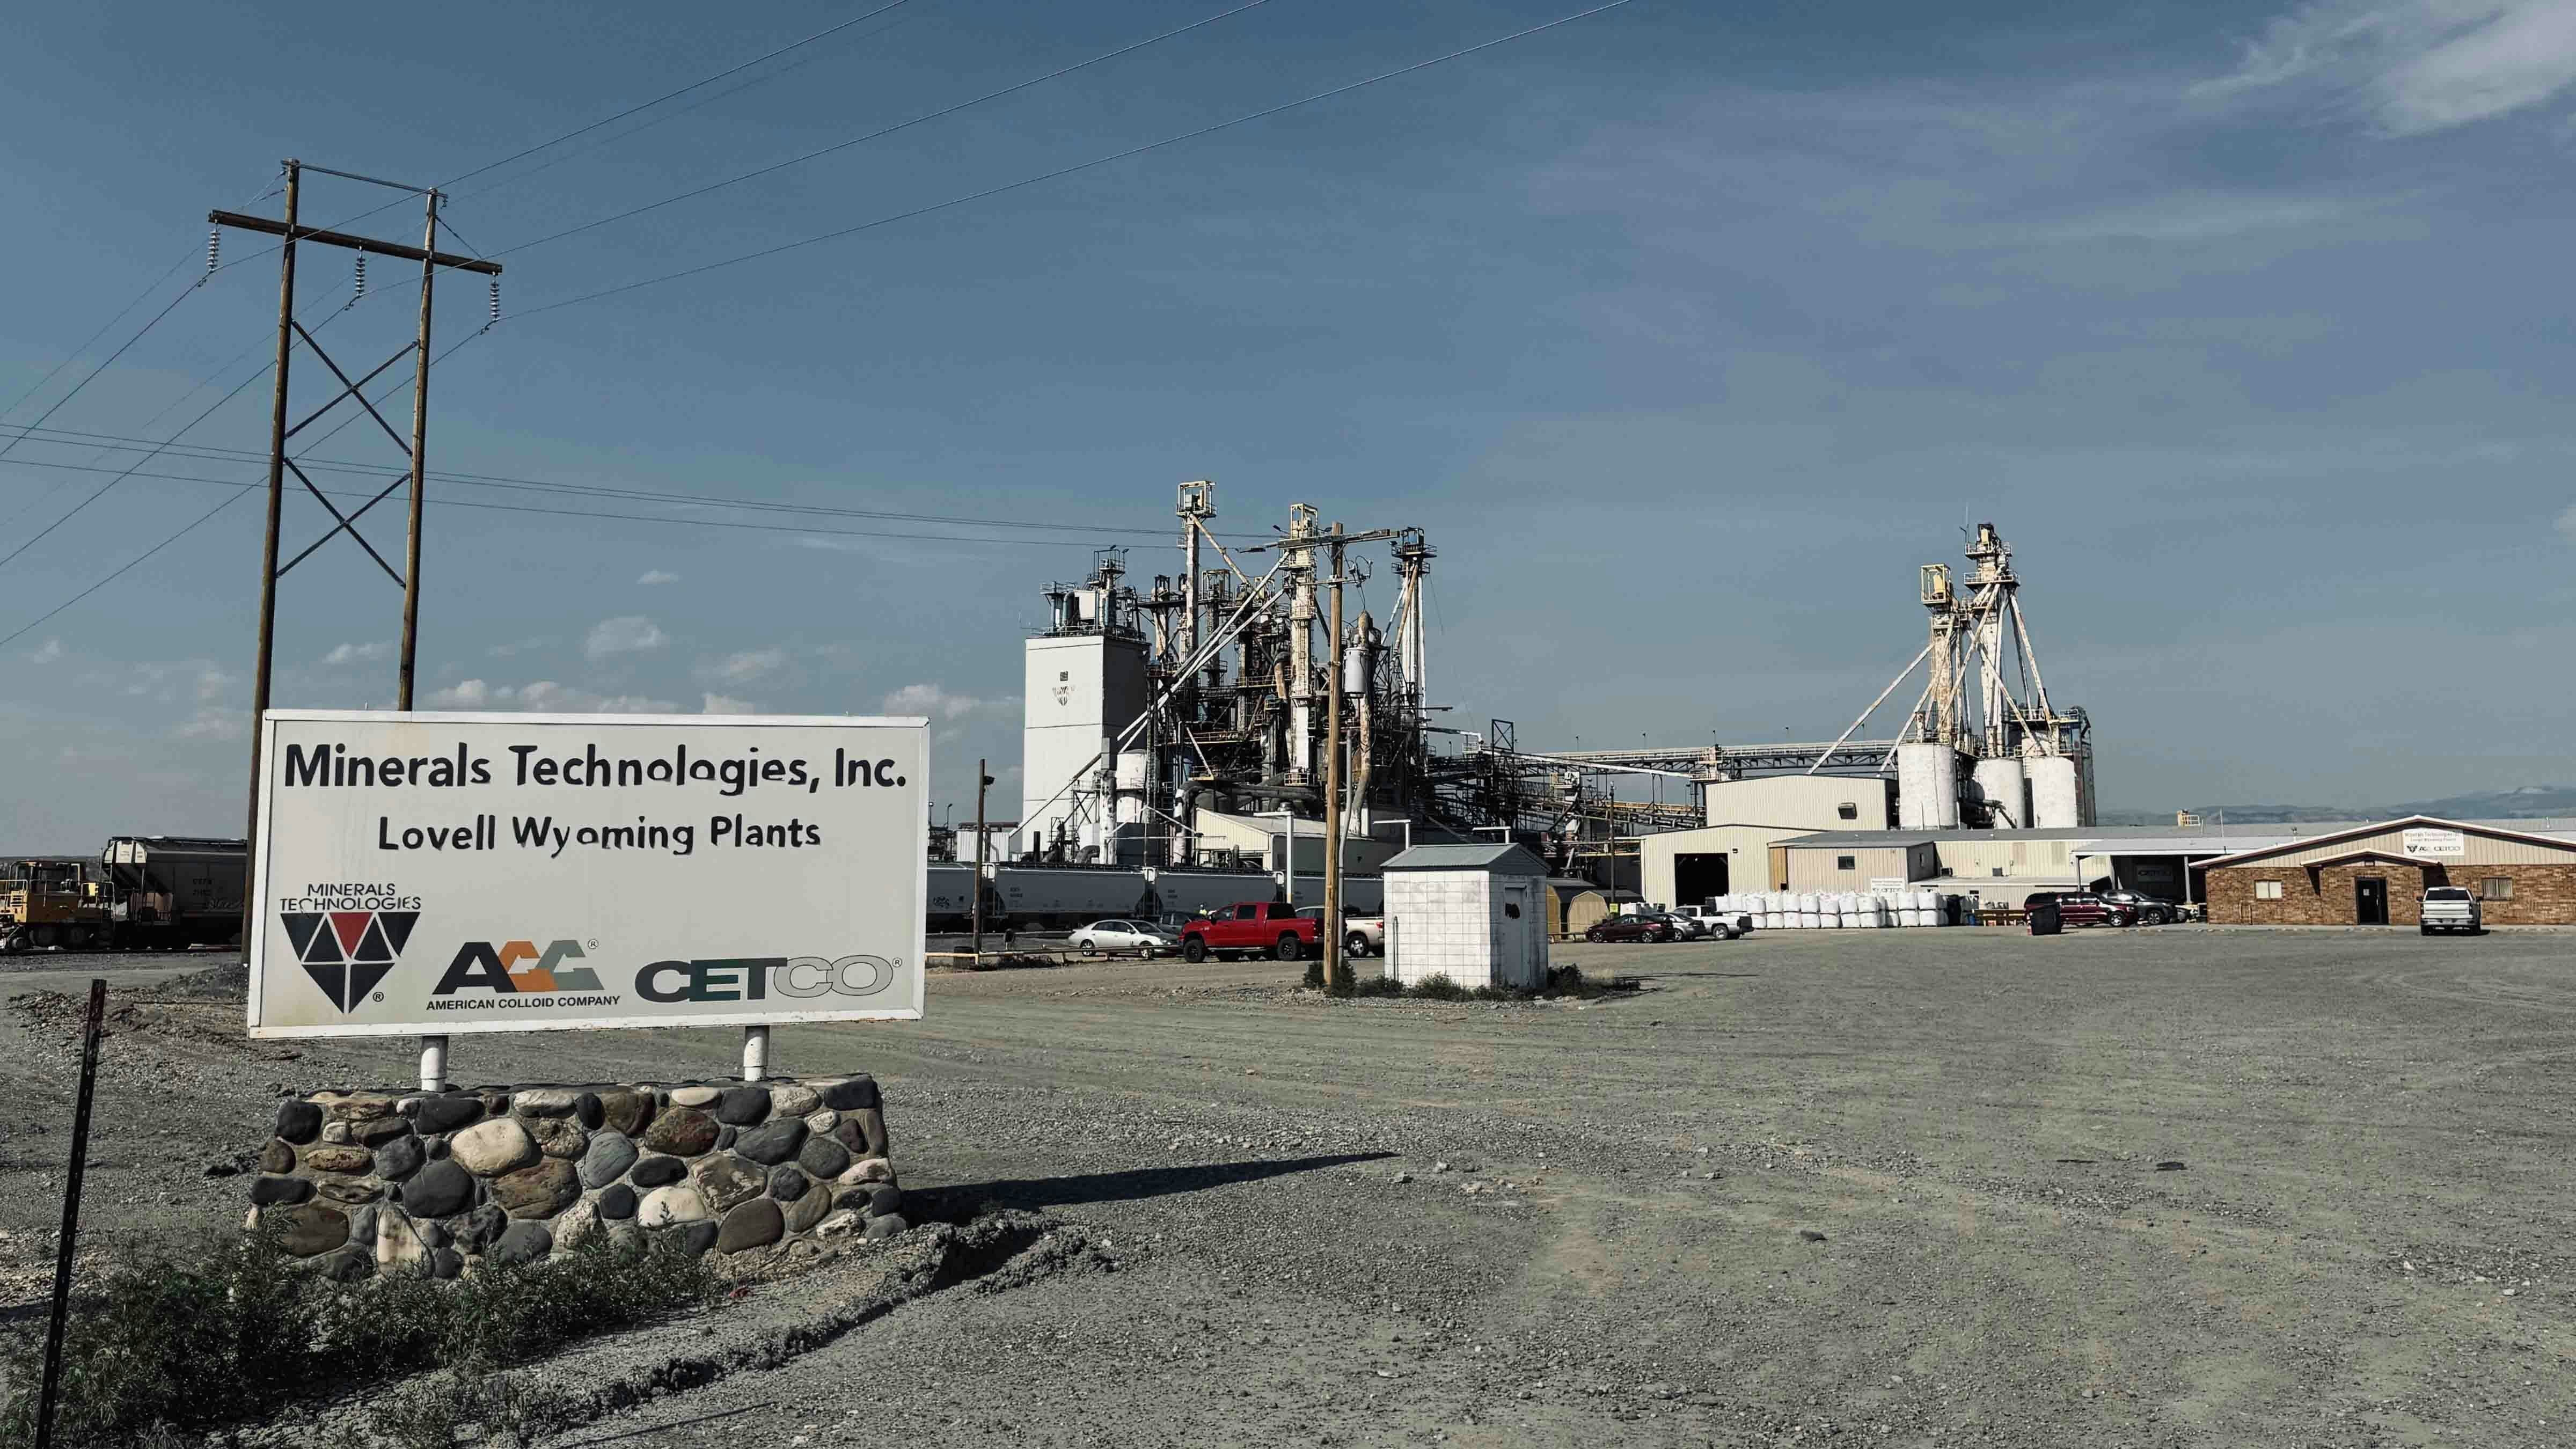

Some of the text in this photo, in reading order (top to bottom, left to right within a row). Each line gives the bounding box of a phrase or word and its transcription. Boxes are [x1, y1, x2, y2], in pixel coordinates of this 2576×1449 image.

[285, 742, 906, 796] Minerals Technologies, Inc.
[379, 813, 821, 859] Lovell Wyoming Plants
[280, 896, 421, 911] TECHNOLOGIES
[308, 883, 396, 897] MINERALS
[634, 954, 894, 1003] CETCO
[426, 996, 620, 1011] AMERICAN COLLOID COMPANY
